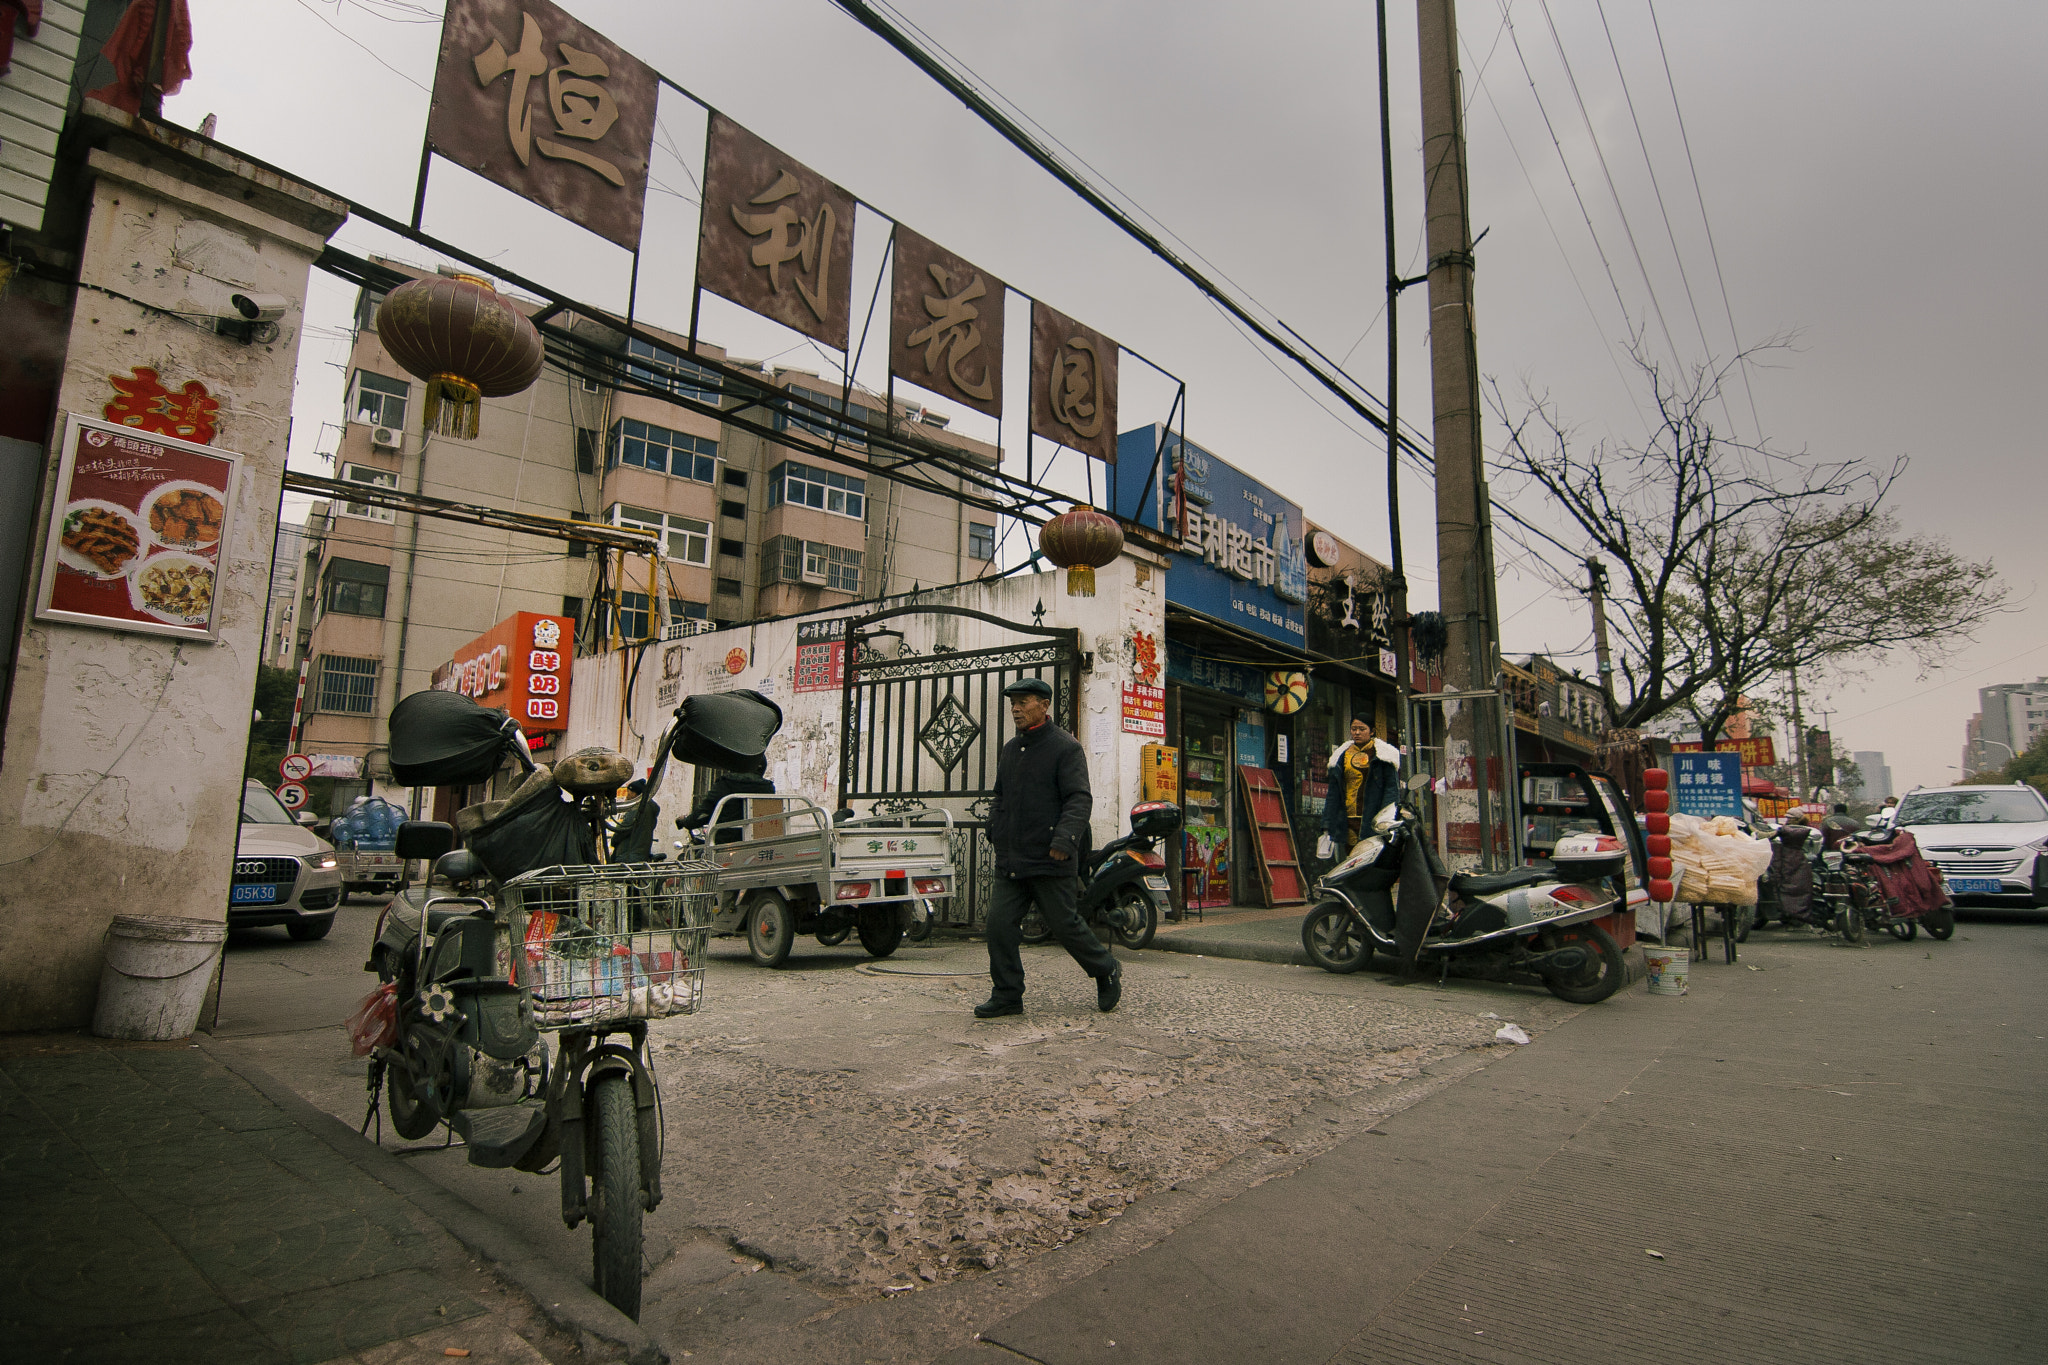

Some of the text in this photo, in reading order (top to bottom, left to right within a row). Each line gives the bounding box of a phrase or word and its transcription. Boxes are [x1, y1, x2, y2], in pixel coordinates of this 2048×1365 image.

[1168, 499, 1275, 587] 恒利超市
[1245, 603, 1257, 617] 电信
[1191, 656, 1244, 692] 恒利超市
[528, 650, 560, 719] 鲜奶吧
[1681, 759, 1722, 770] 川味
[1680, 773, 1724, 785] 麻辣烫
[285, 789, 299, 804] 5
